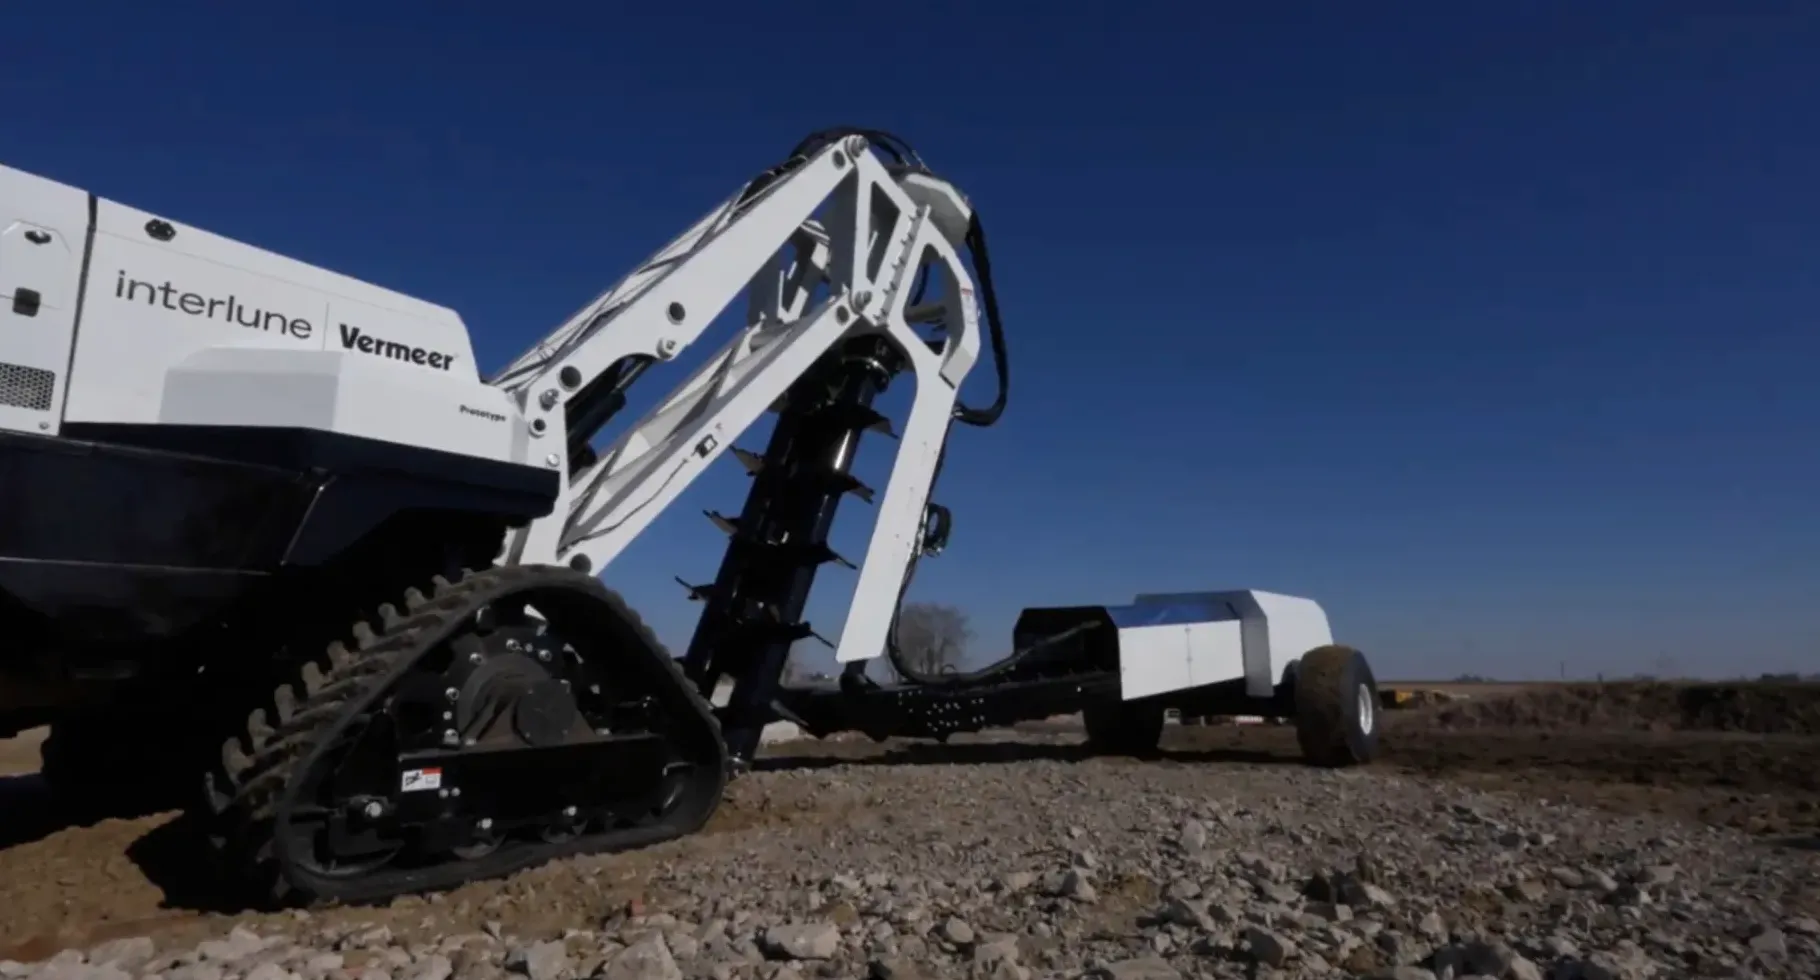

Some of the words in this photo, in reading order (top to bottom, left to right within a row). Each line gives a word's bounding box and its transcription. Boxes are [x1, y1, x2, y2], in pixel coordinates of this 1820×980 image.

[116, 270, 312, 339] interlune
[339, 323, 454, 371] Vermeer
[459, 404, 507, 422] Prototype
